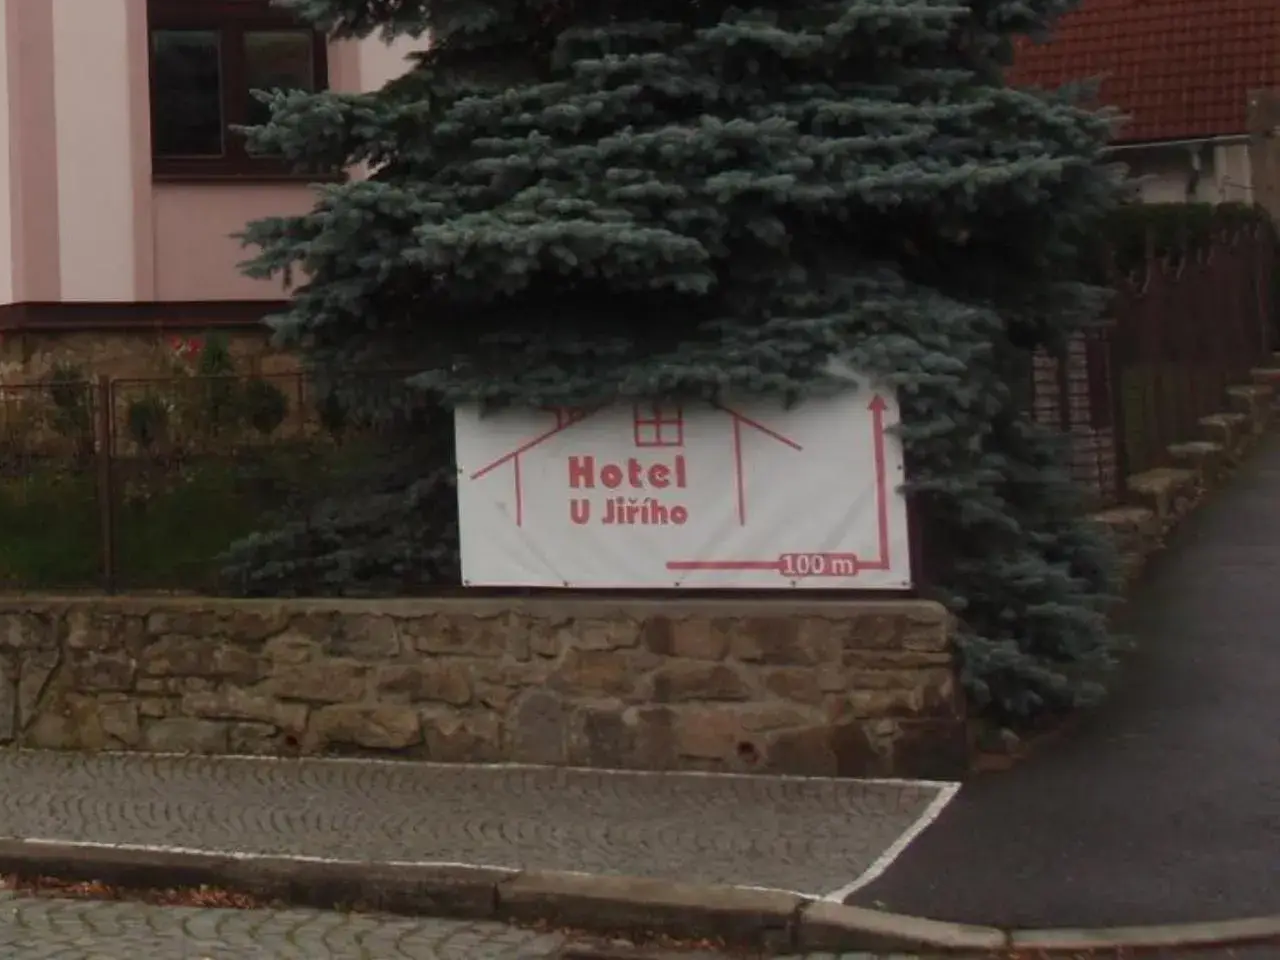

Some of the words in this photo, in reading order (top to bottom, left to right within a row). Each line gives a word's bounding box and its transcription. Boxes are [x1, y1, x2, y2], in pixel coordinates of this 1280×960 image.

[568, 454, 687, 489] Hotel
[569, 498, 591, 525] U
[601, 496, 689, 525] Jiřího
[782, 555, 825, 574] 100
[831, 558, 854, 574] m
